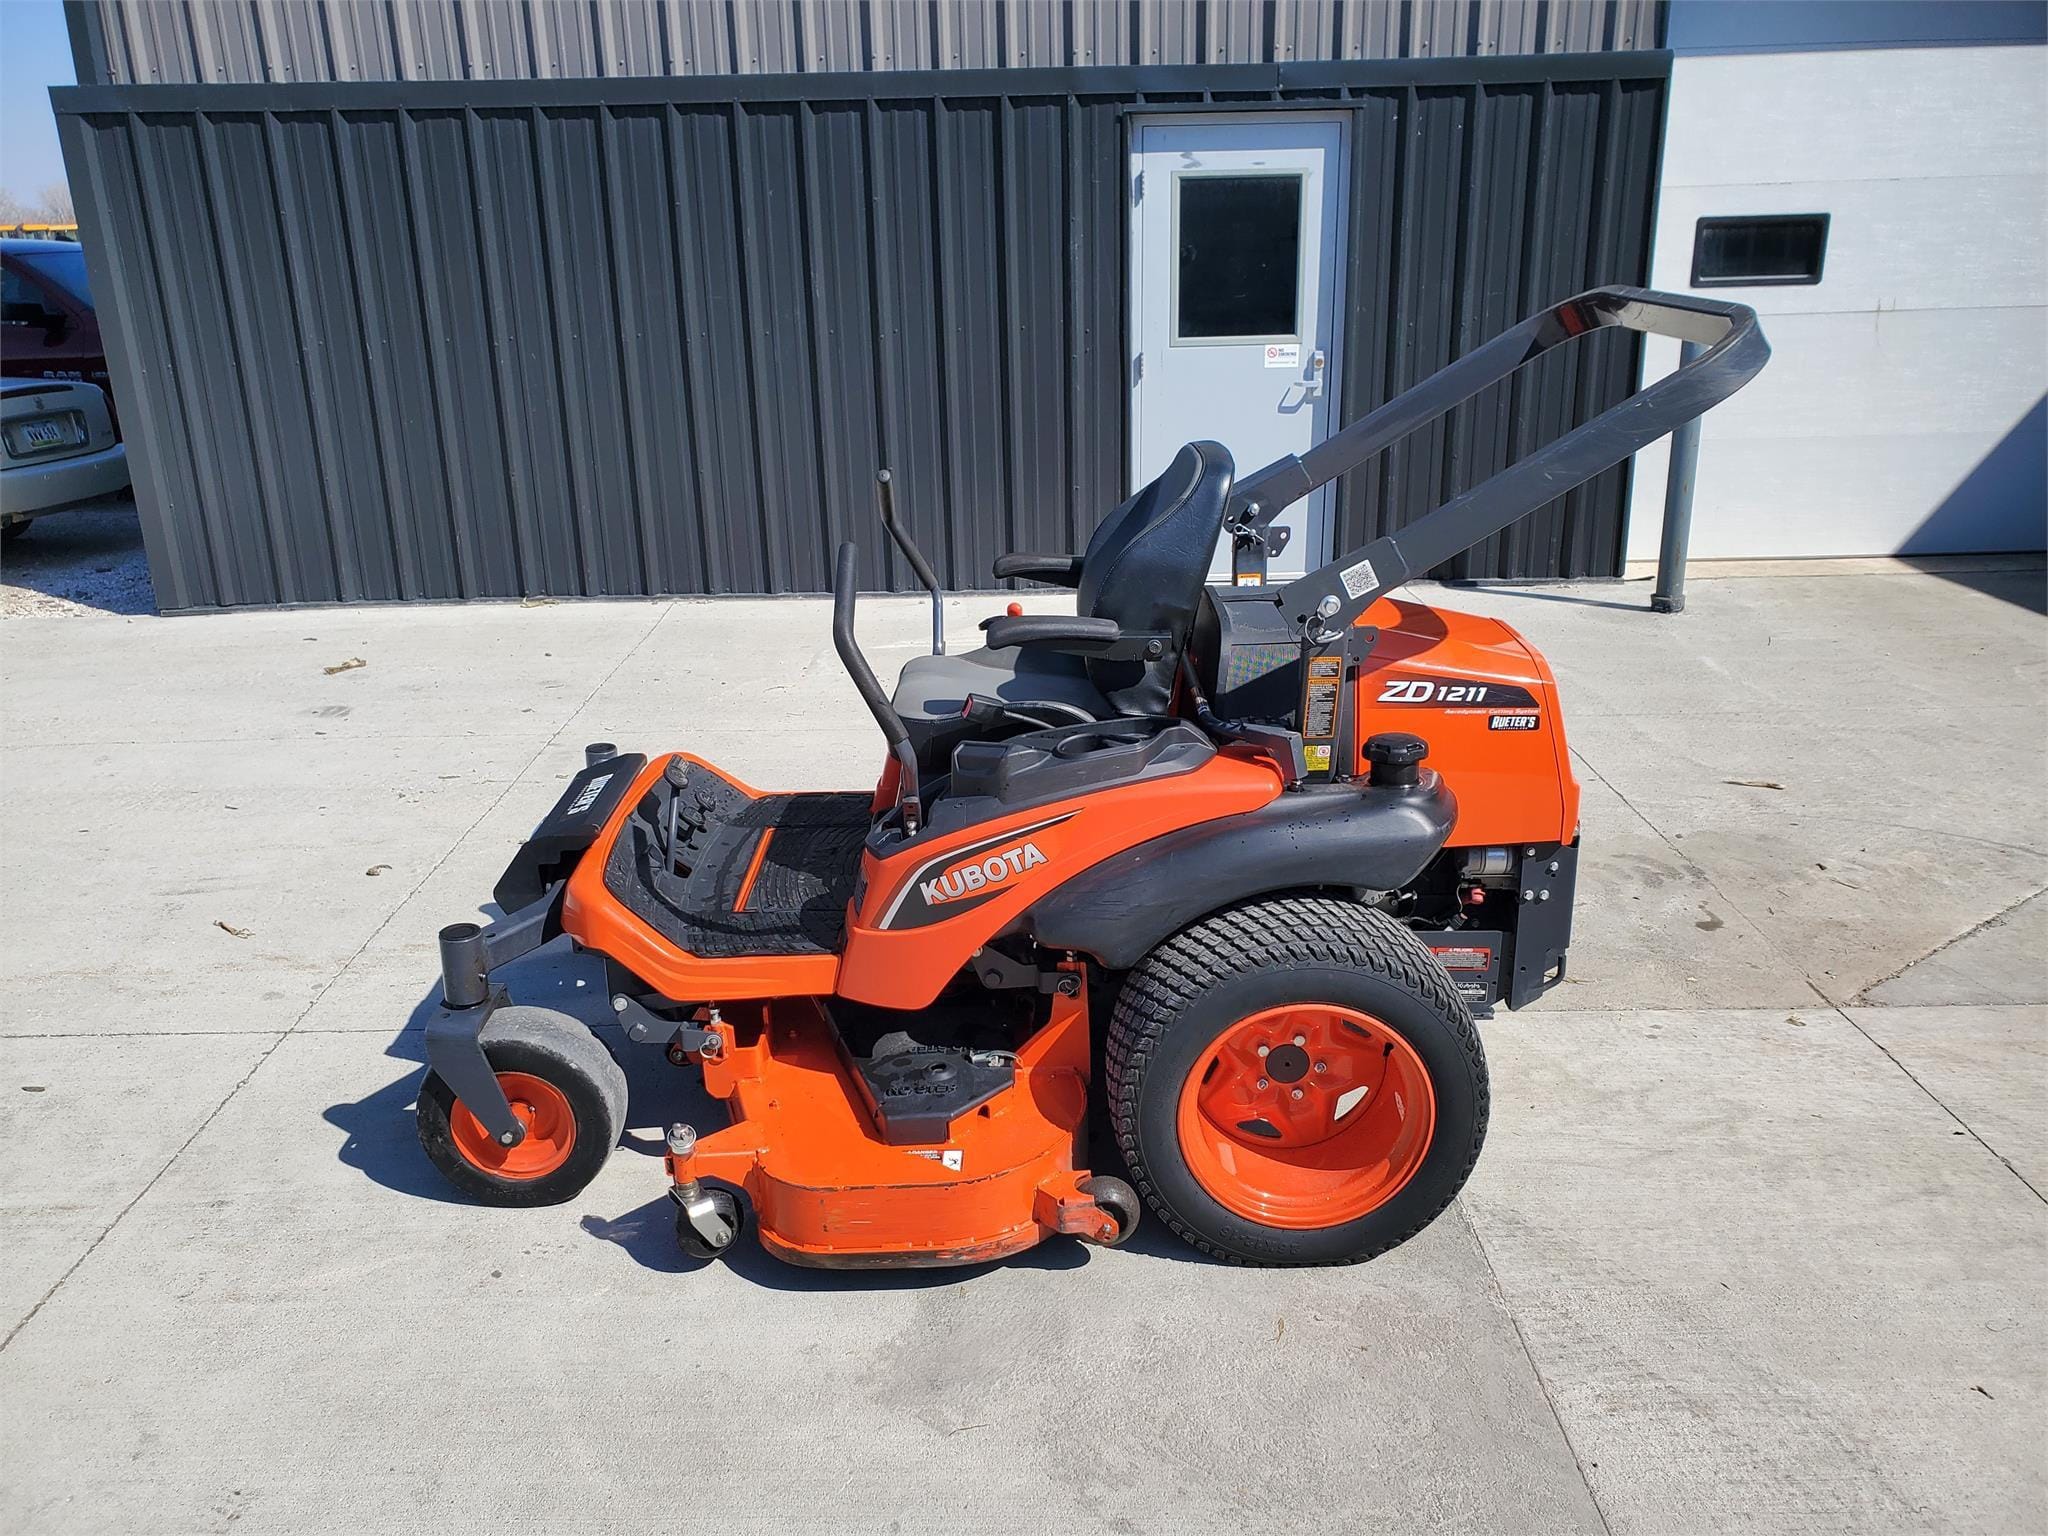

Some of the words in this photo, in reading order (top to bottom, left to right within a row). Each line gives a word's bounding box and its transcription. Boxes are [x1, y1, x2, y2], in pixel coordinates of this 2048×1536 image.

[1376, 680, 1435, 703] ZD
[1436, 686, 1488, 702] 1211
[1491, 716, 1536, 729] RUETER'S
[919, 841, 1049, 906] KUBOTA
